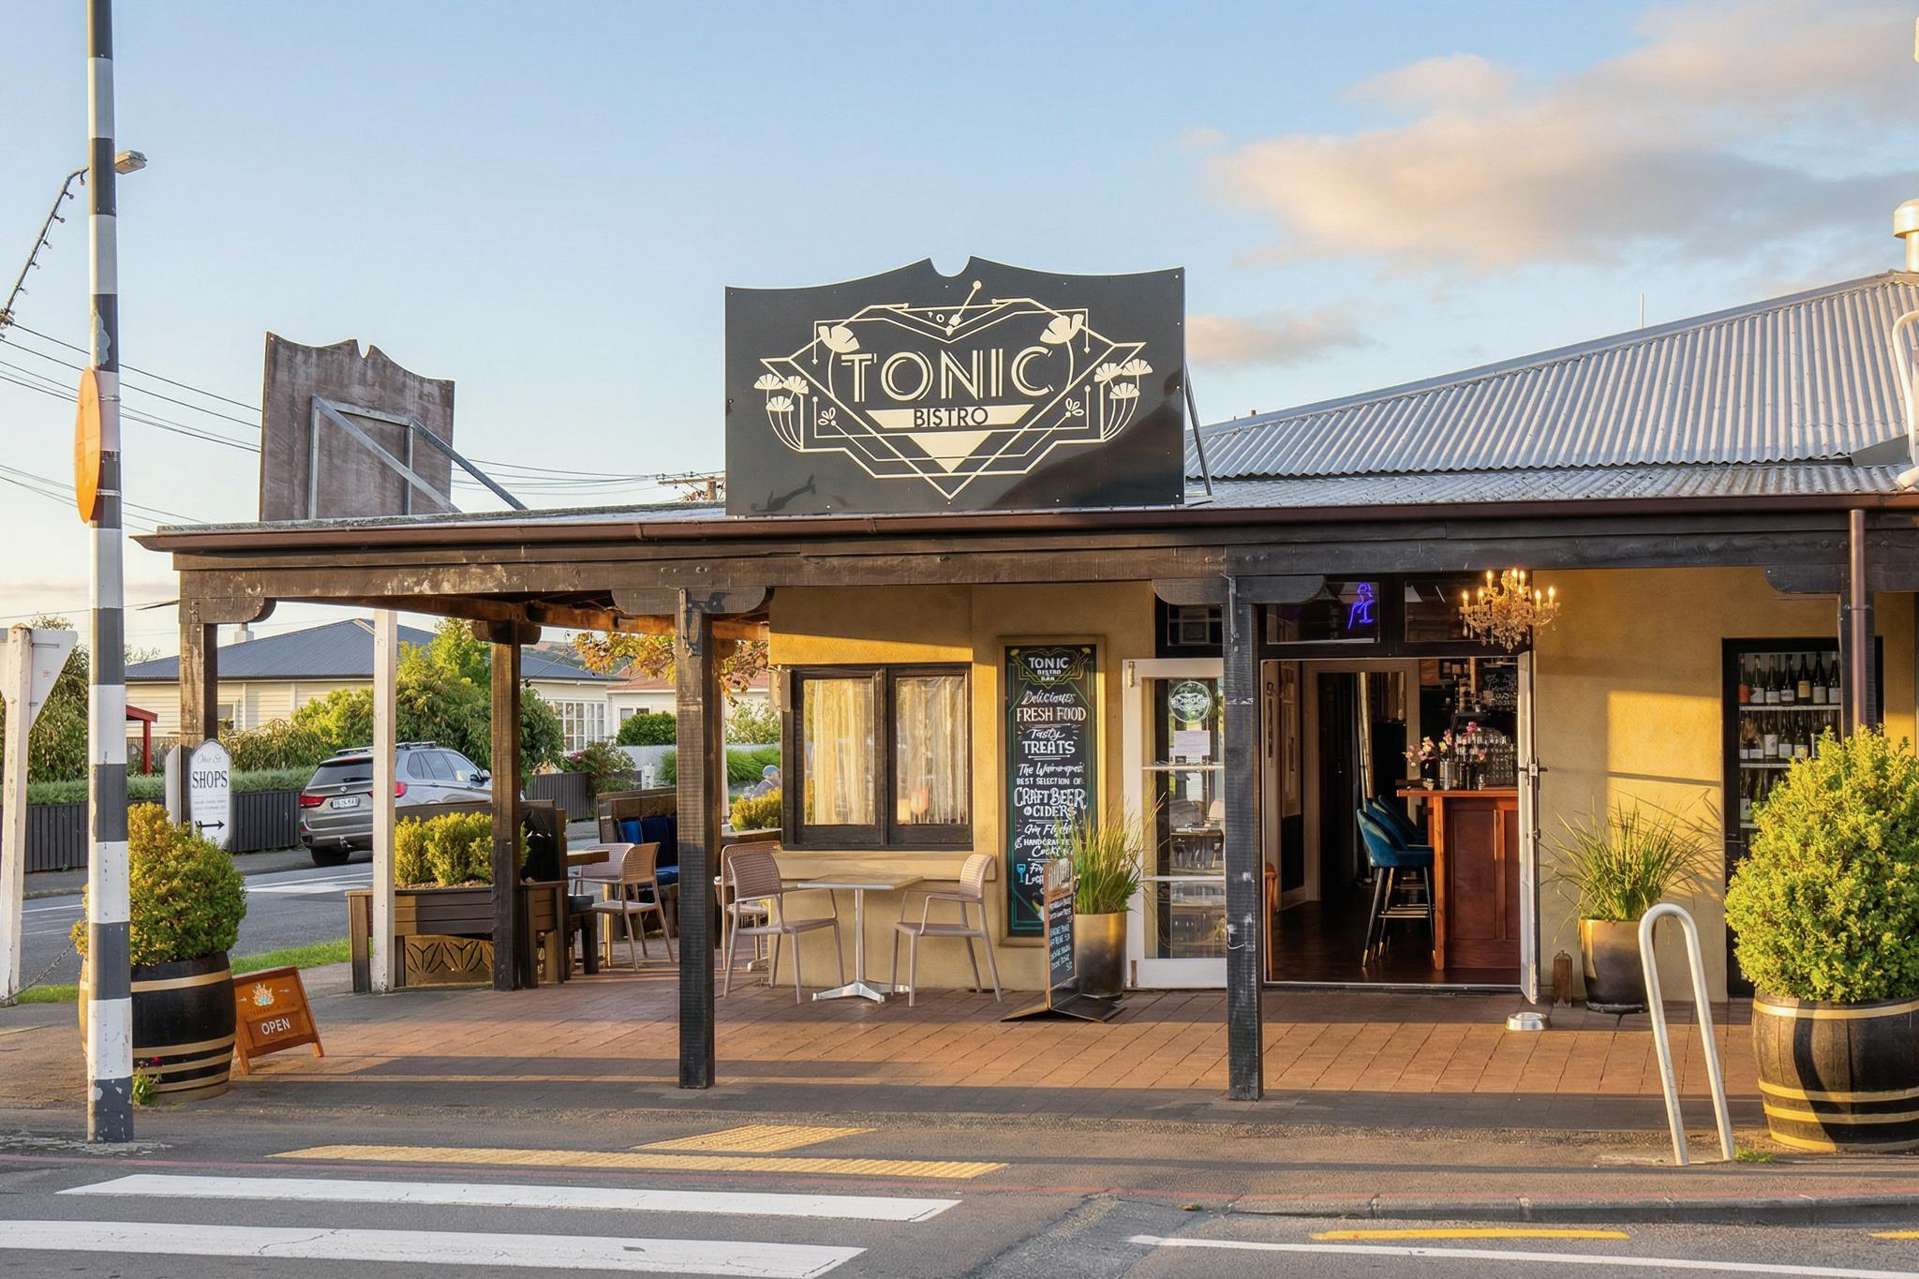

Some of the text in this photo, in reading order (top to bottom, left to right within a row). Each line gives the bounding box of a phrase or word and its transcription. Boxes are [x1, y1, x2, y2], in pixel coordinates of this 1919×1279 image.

[841, 346, 1054, 403] TONIC
[913, 407, 989, 428] BISTRO
[1028, 657, 1070, 669] TONIC
[1016, 706, 1087, 722] FRESH FOOD
[1026, 727, 1066, 741] Tasty
[1022, 741, 1076, 754] TREATS
[1017, 763, 1034, 777] The
[192, 770, 228, 789] SHOPS
[1016, 777, 1083, 785] BEST SELECTION OF
[1014, 787, 1088, 810] CRAFT BEER
[261, 1018, 291, 1035] OPEN
